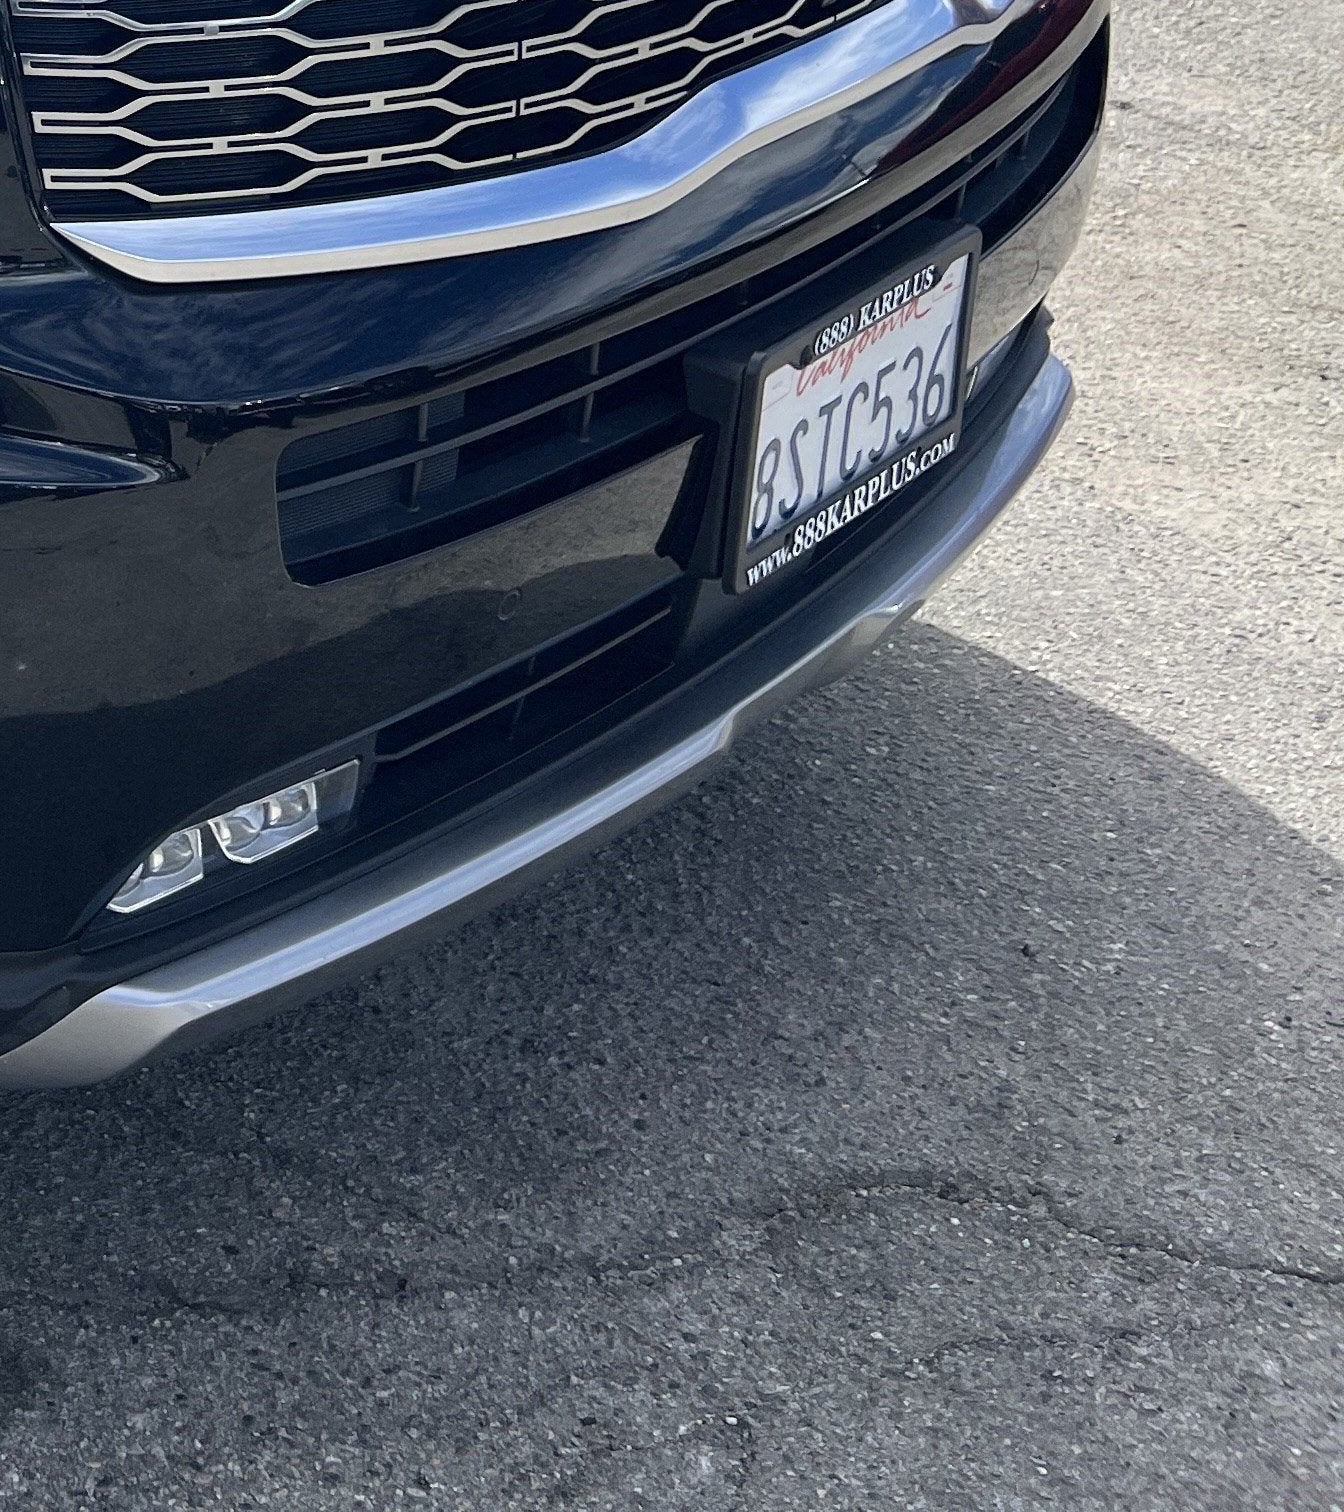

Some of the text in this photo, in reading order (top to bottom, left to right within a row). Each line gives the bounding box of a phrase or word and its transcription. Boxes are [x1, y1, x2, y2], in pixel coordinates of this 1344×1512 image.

[814, 264, 935, 356] (888) KARPLUS
[750, 322, 953, 535] 8STC536
